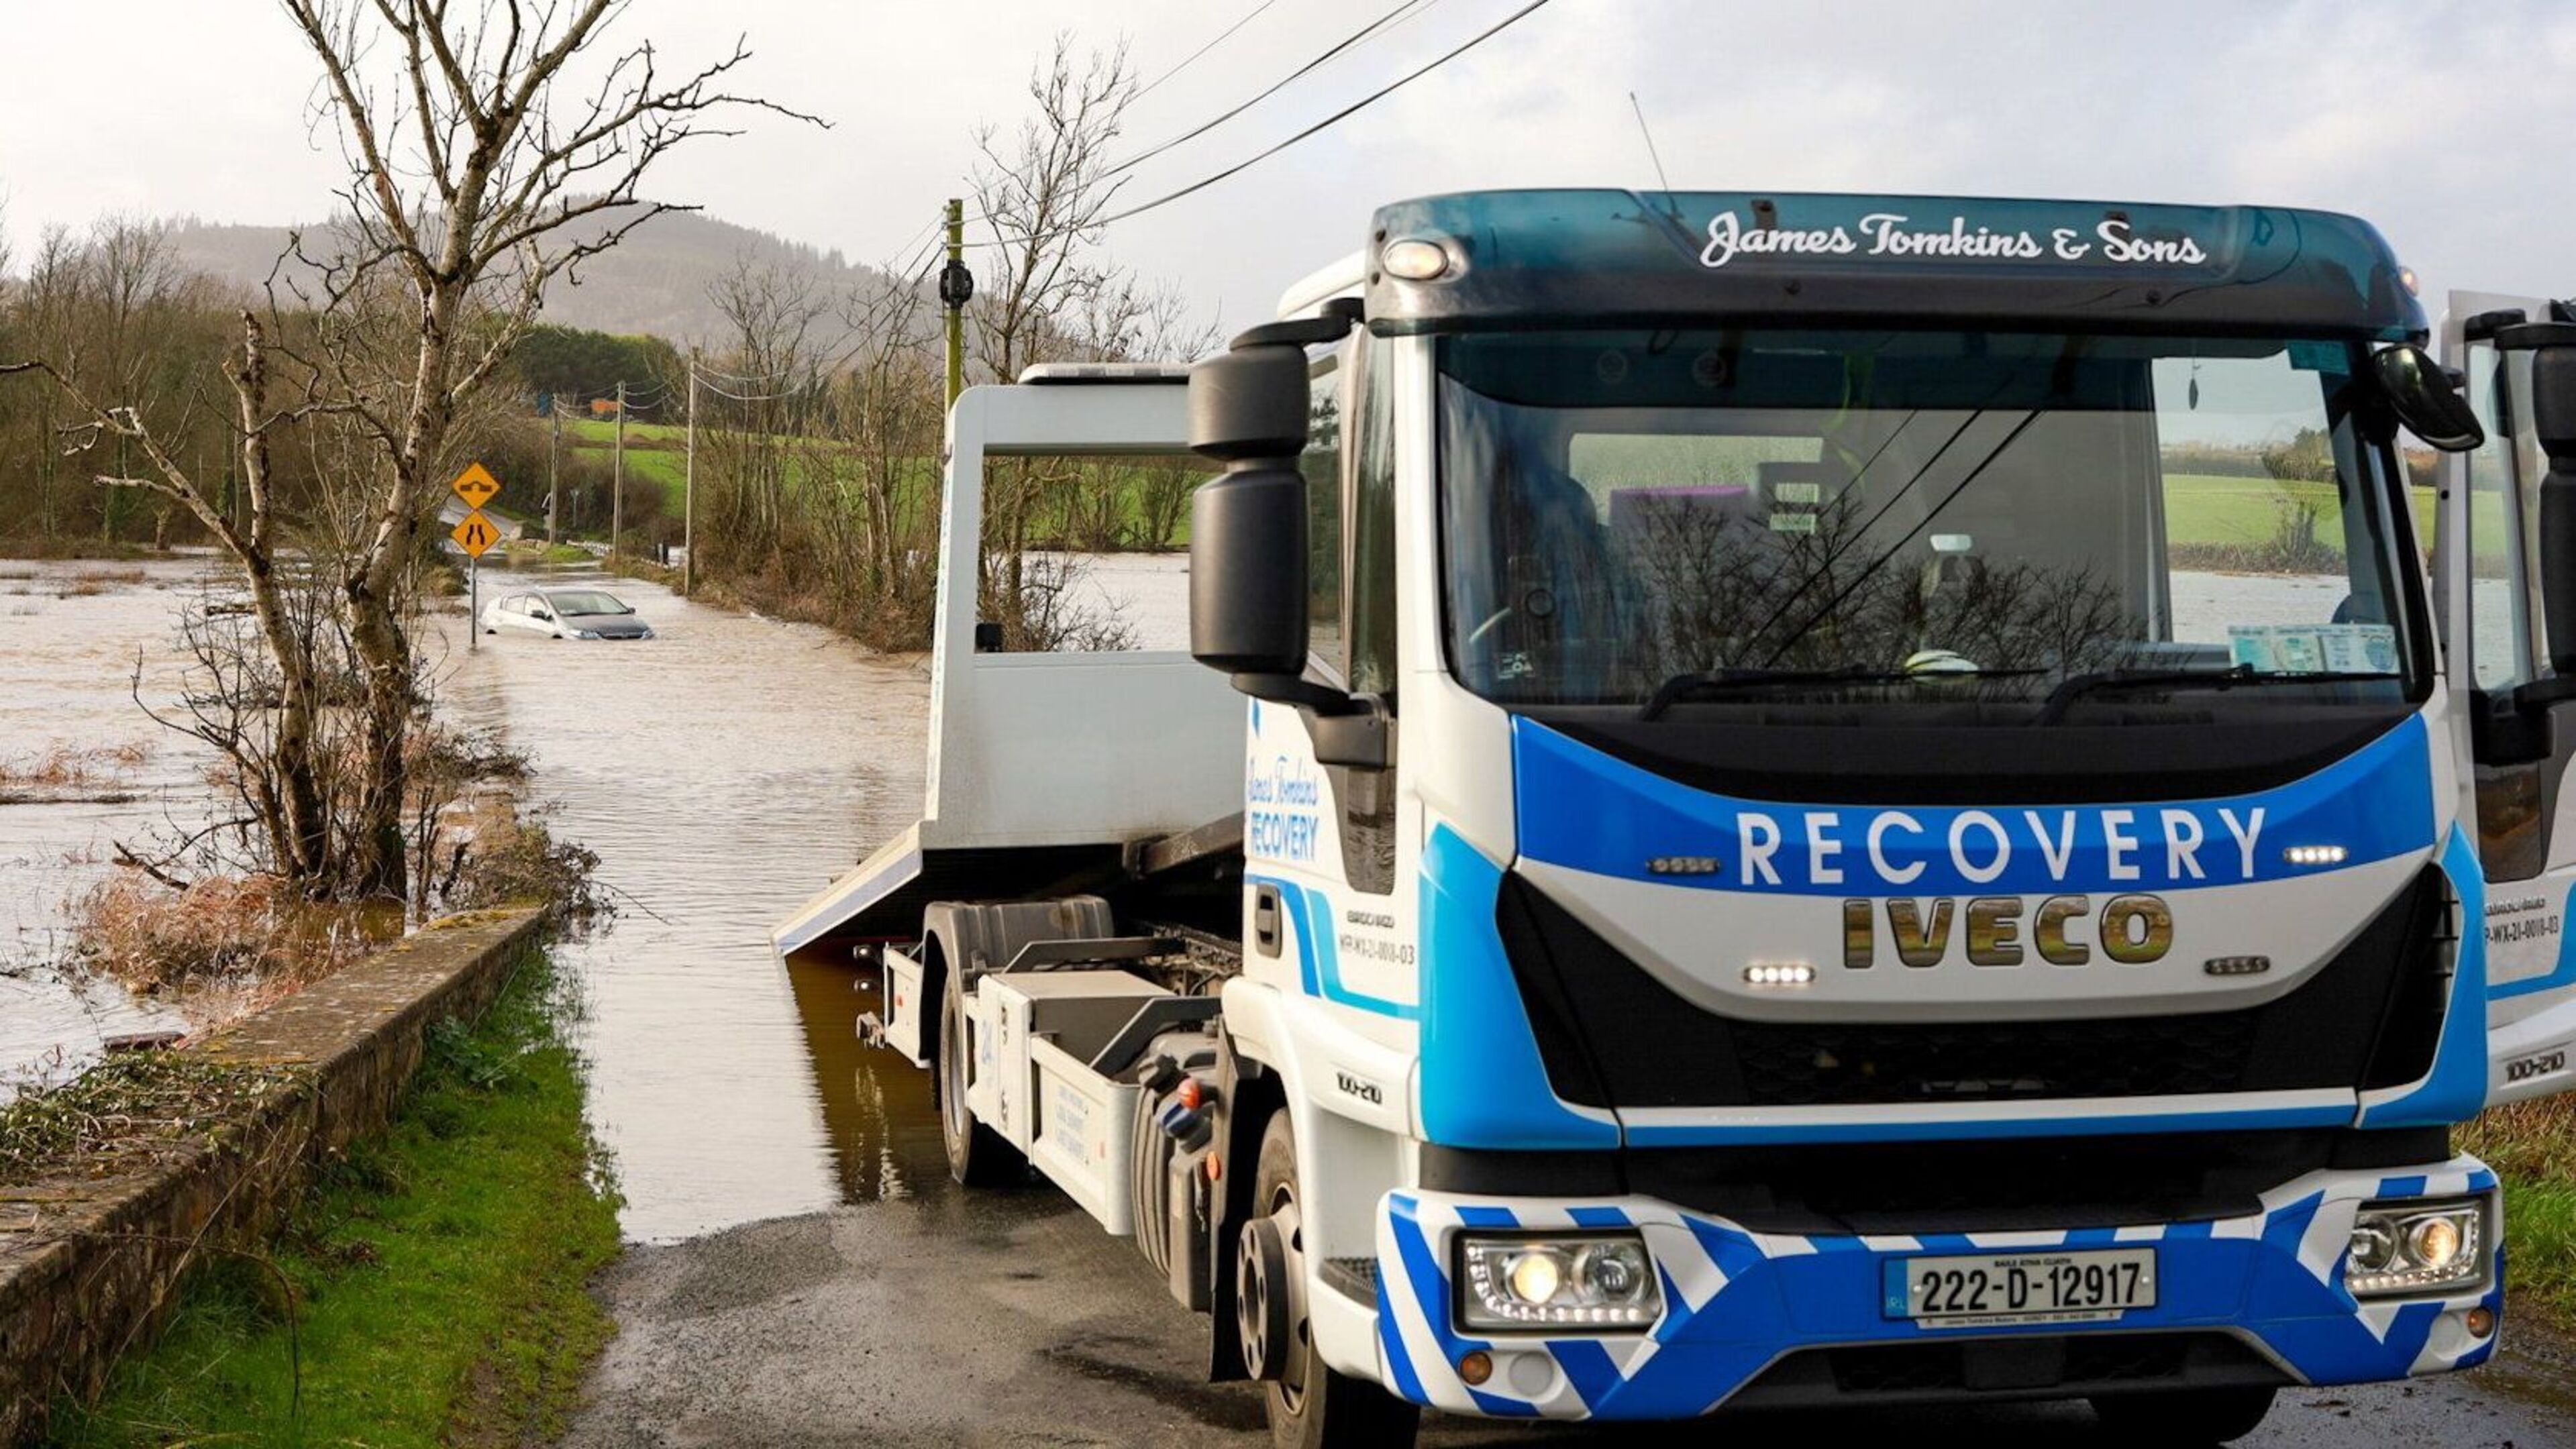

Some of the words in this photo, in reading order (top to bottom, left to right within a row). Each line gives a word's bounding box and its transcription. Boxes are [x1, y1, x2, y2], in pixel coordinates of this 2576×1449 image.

[1700, 211, 1857, 267] James
[1859, 213, 2042, 258] Tomkins
[2052, 228, 2090, 260] &
[2097, 220, 2206, 264] Sons
[1736, 807, 2267, 886] RECOVERY
[1843, 893, 2175, 969] IVECO
[1922, 1263, 2141, 1312] 222-D-12917
